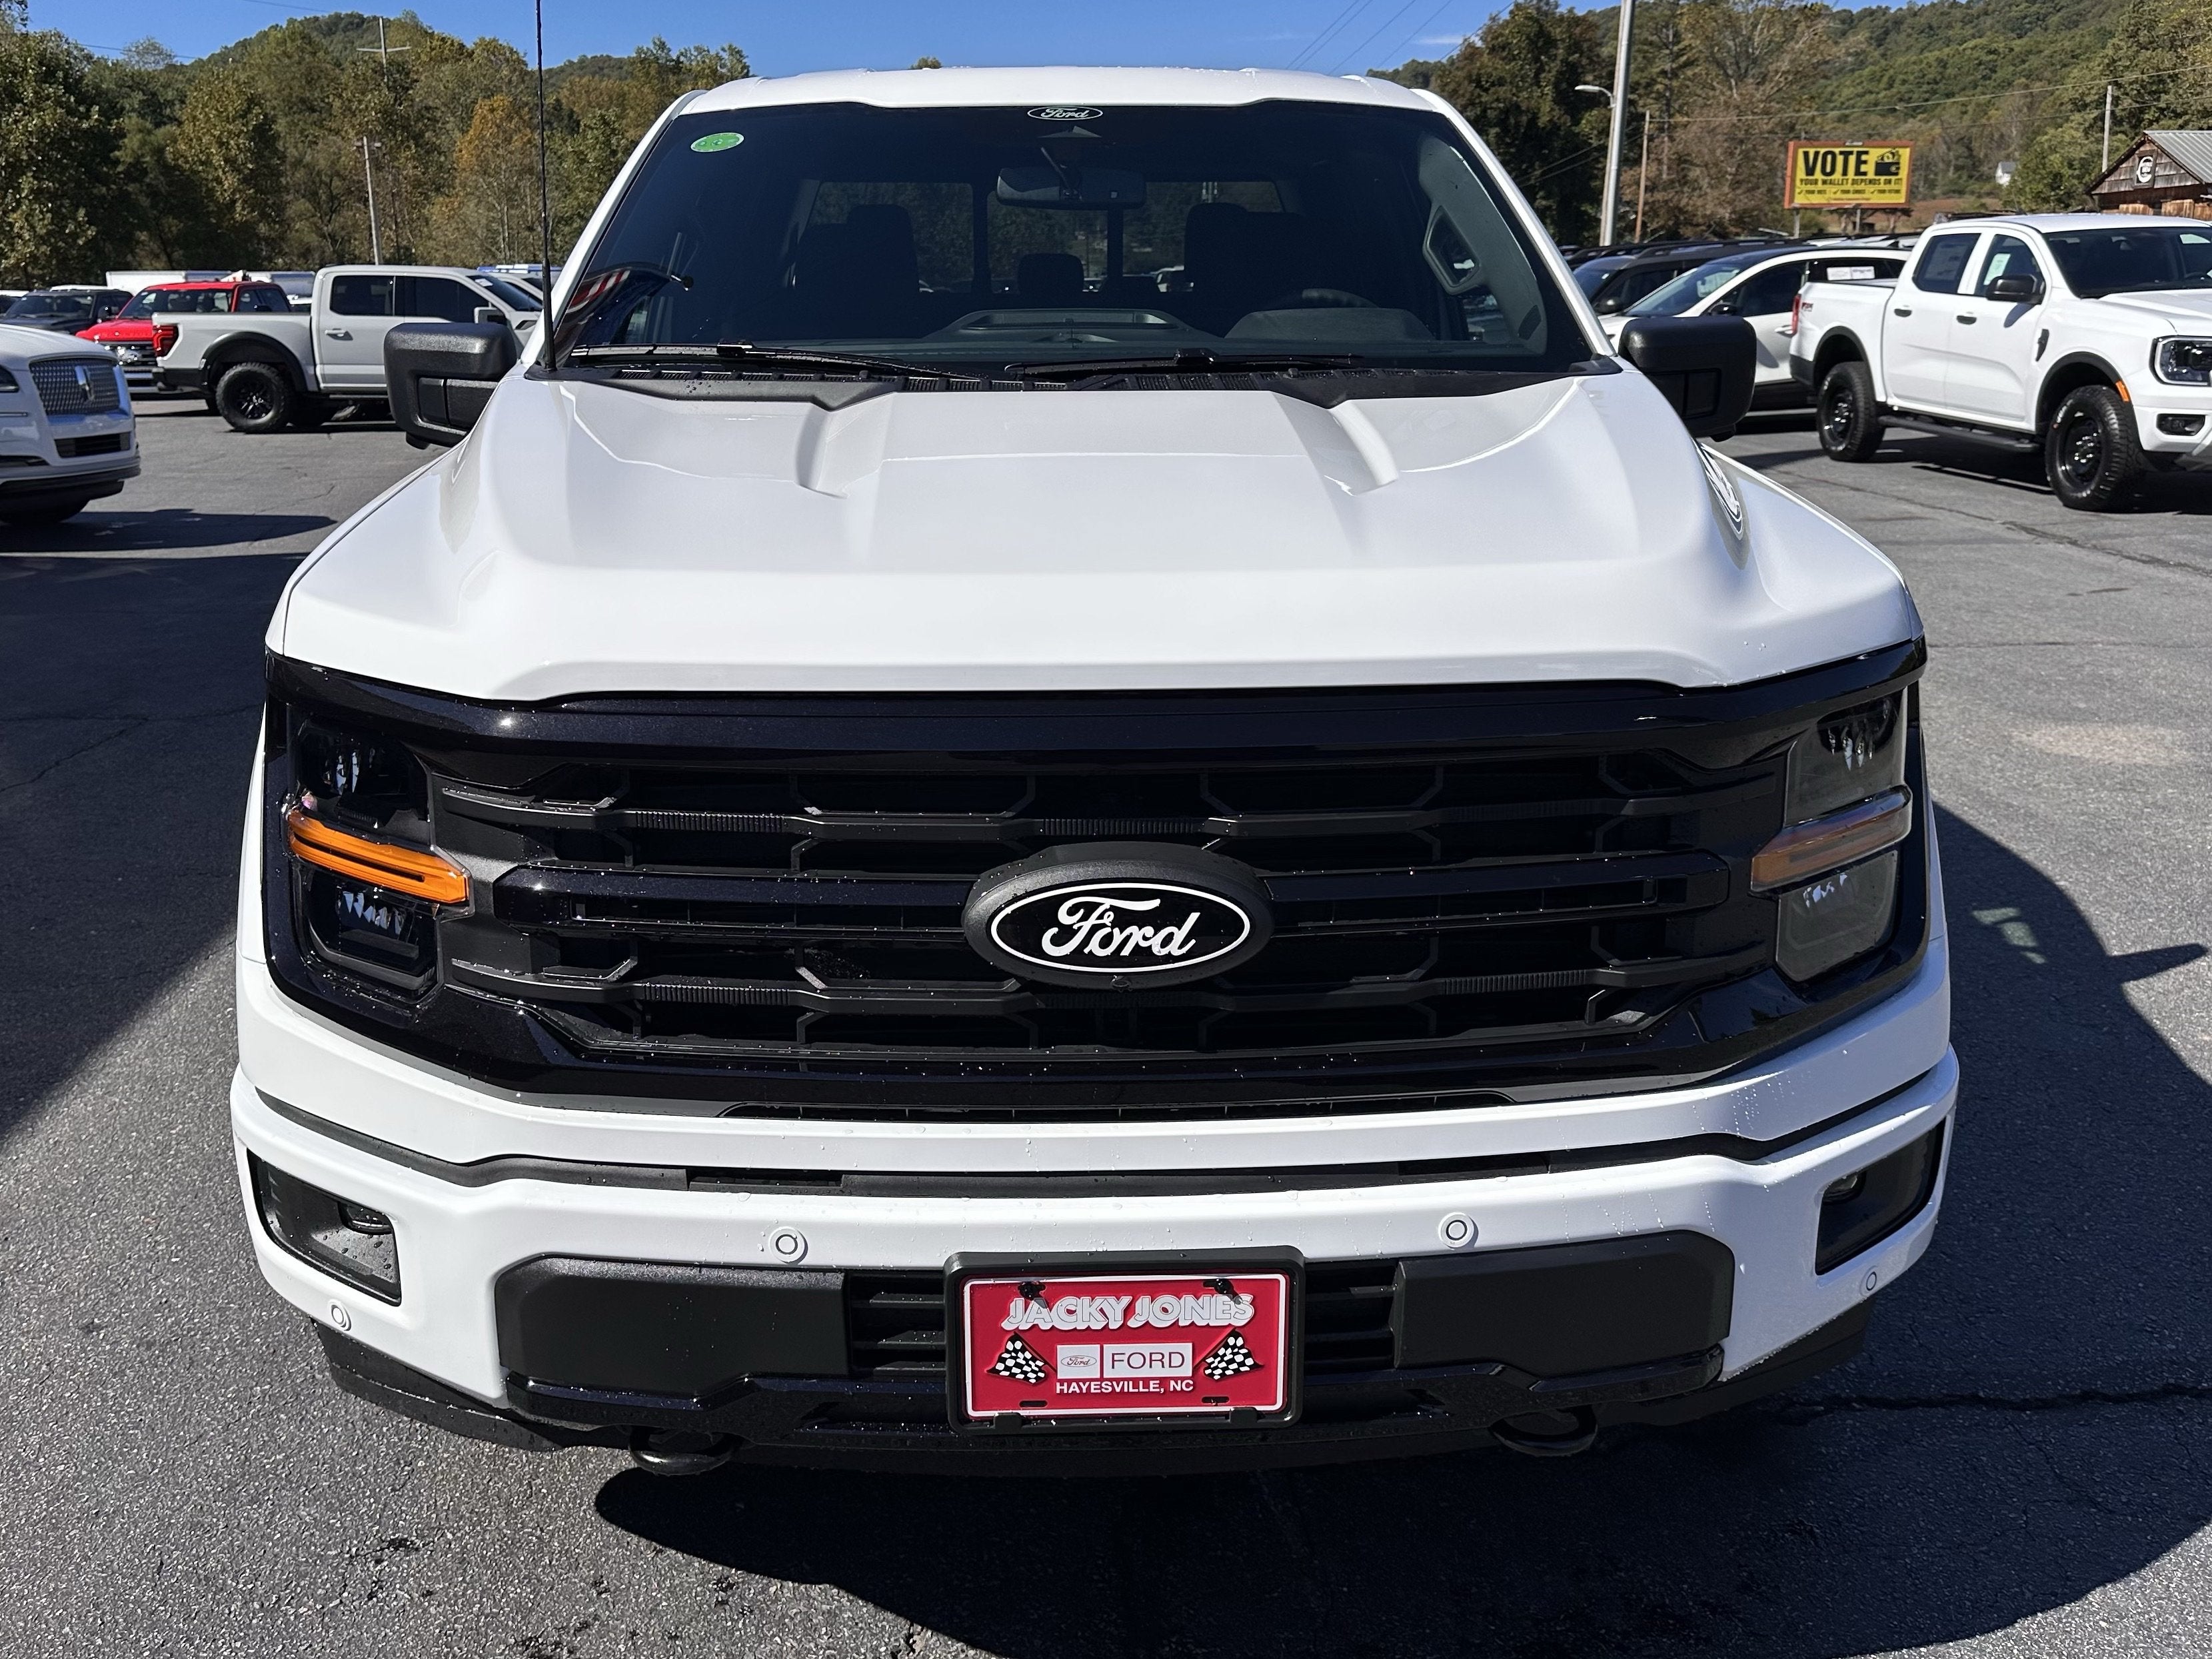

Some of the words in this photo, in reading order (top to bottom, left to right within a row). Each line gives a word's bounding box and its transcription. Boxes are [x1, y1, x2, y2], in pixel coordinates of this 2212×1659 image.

[1040, 107, 1090, 118] Ford
[1803, 150, 1869, 177] VOTE
[1042, 896, 1200, 956] Ford
[1001, 1294, 1132, 1330] JACKY
[1126, 1293, 1255, 1329] JONES
[1067, 1356, 1091, 1366] Ford
[1111, 1351, 1185, 1369] FORD
[1056, 1380, 1164, 1394] HAYESVILLE,
[1170, 1379, 1194, 1392] NC
